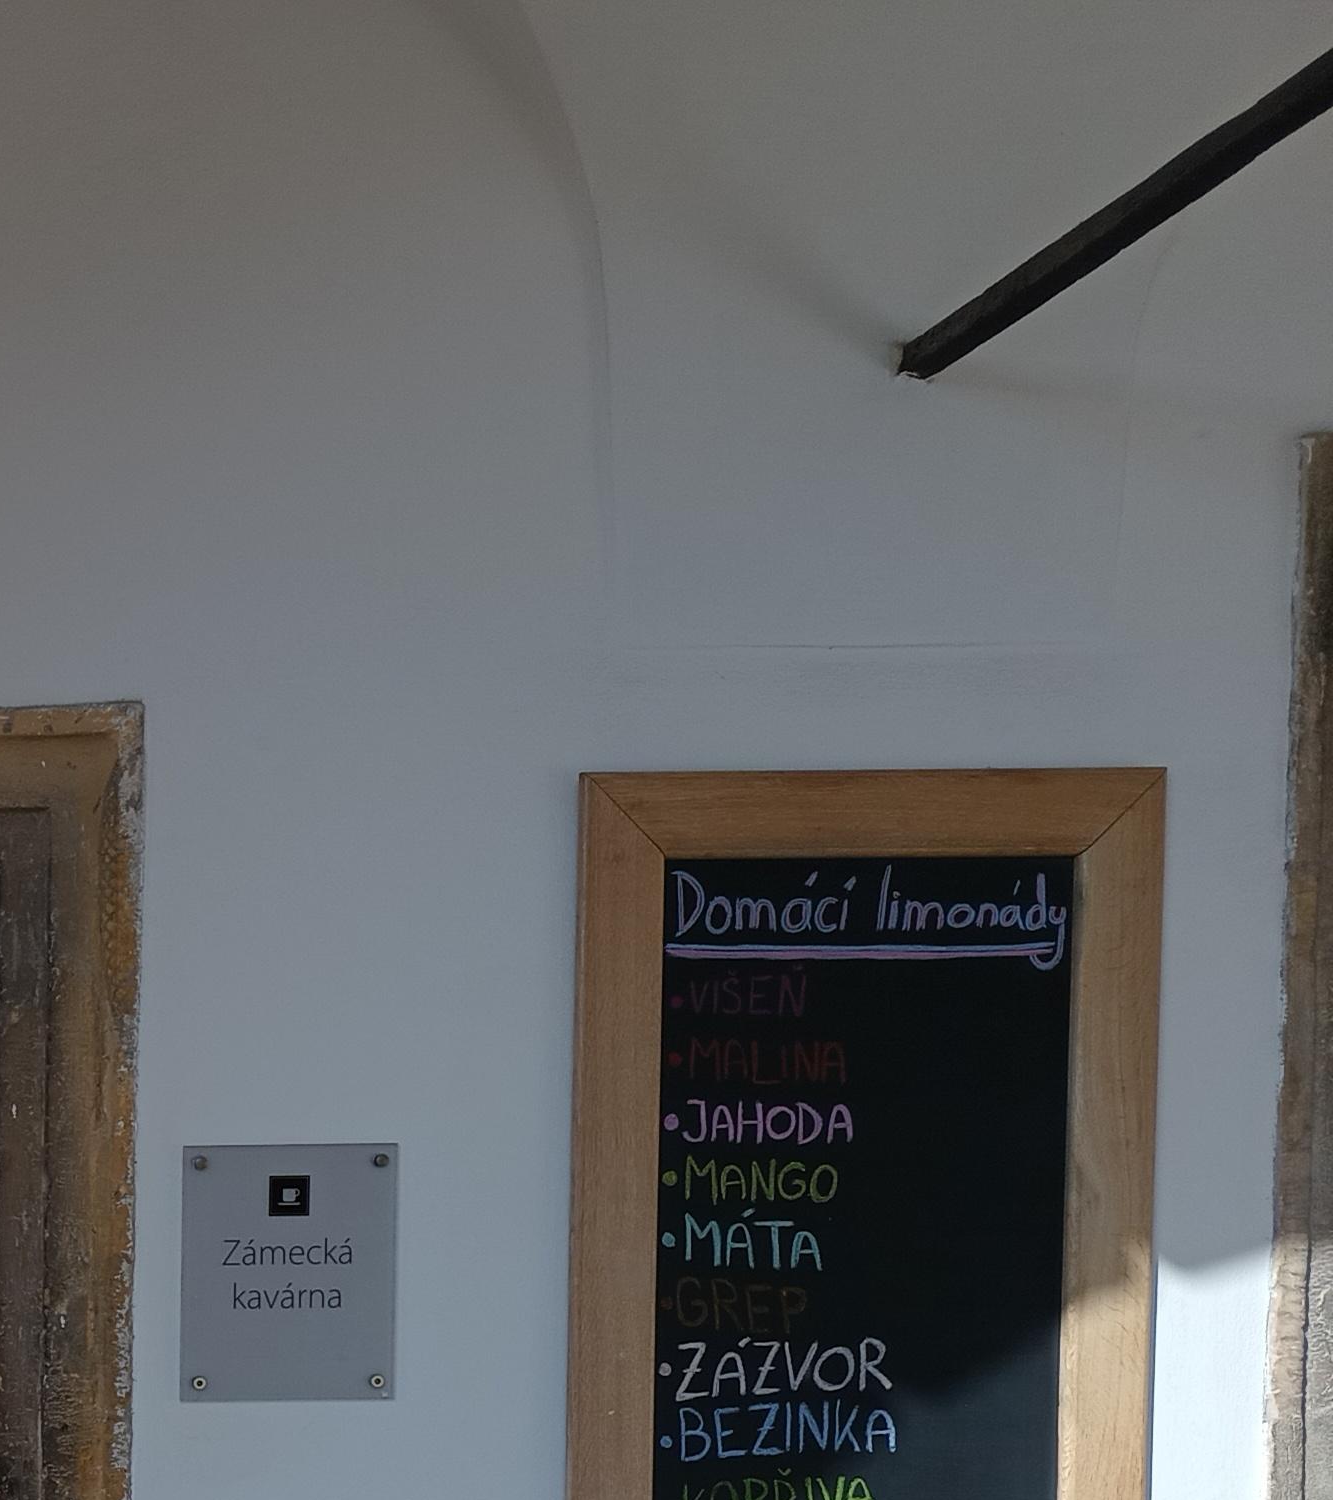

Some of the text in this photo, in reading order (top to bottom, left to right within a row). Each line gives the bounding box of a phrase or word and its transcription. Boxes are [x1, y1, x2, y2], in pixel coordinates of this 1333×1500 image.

[671, 864, 1068, 970] Domácí limonády
[688, 963, 808, 1017] VIŠEŇ
[687, 1038, 849, 1085] MALINA
[682, 1099, 854, 1144] JAHODA
[683, 1155, 838, 1205] MANGO
[222, 1238, 353, 1267] Zámecká
[683, 1208, 824, 1271] MÁTA
[232, 1282, 342, 1310] kavárna
[675, 1275, 807, 1333] GREP
[675, 1336, 893, 1402] ZÁZVOR
[680, 1399, 897, 1462] BEZINKA
